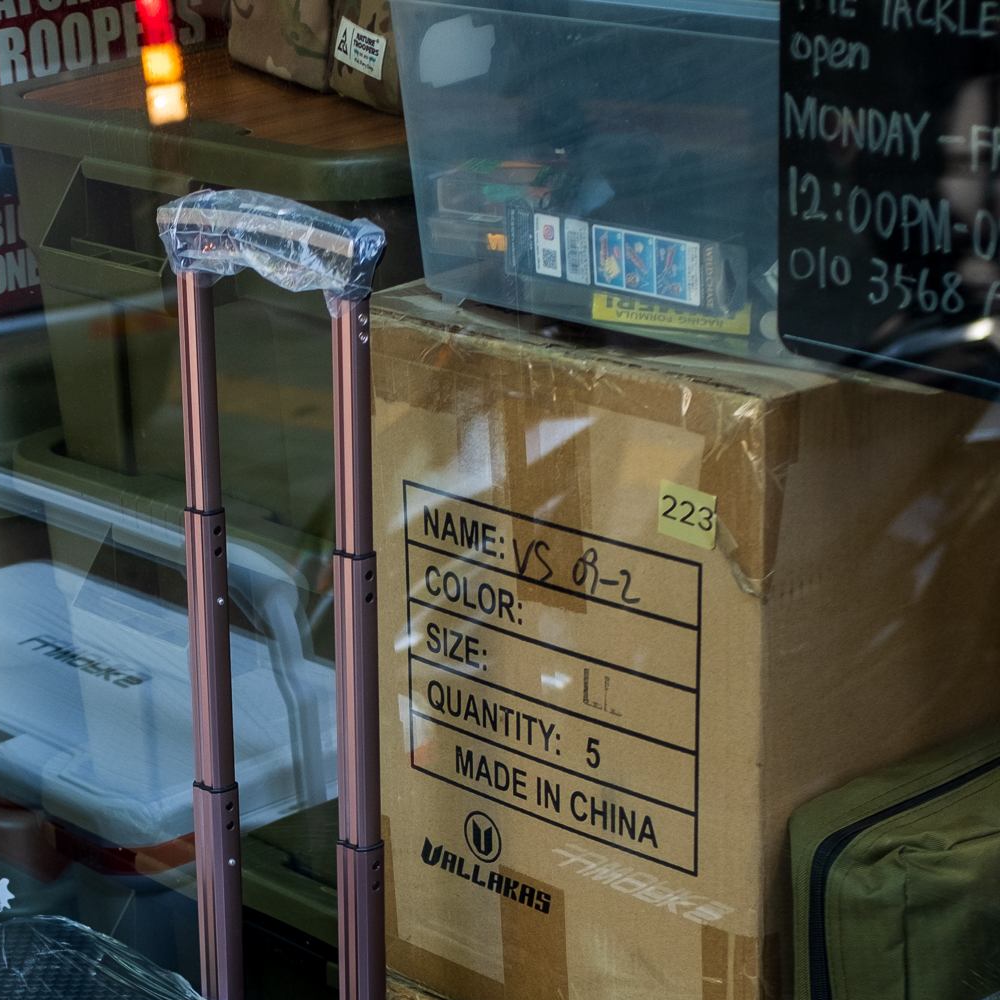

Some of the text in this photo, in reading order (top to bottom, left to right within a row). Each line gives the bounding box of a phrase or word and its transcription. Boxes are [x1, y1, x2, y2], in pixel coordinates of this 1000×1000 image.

[790, 32, 870, 77] open
[784, 91, 931, 161] MONDAY
[869, 257, 965, 313] 3568
[423, 505, 506, 560] NAME:
[661, 494, 713, 533] 223
[425, 565, 524, 625] COLOR:
[426, 622, 489, 671] SIZE:
[427, 680, 601, 769] QUANTITY: 5
[455, 745, 659, 849] MADE IN CHINA
